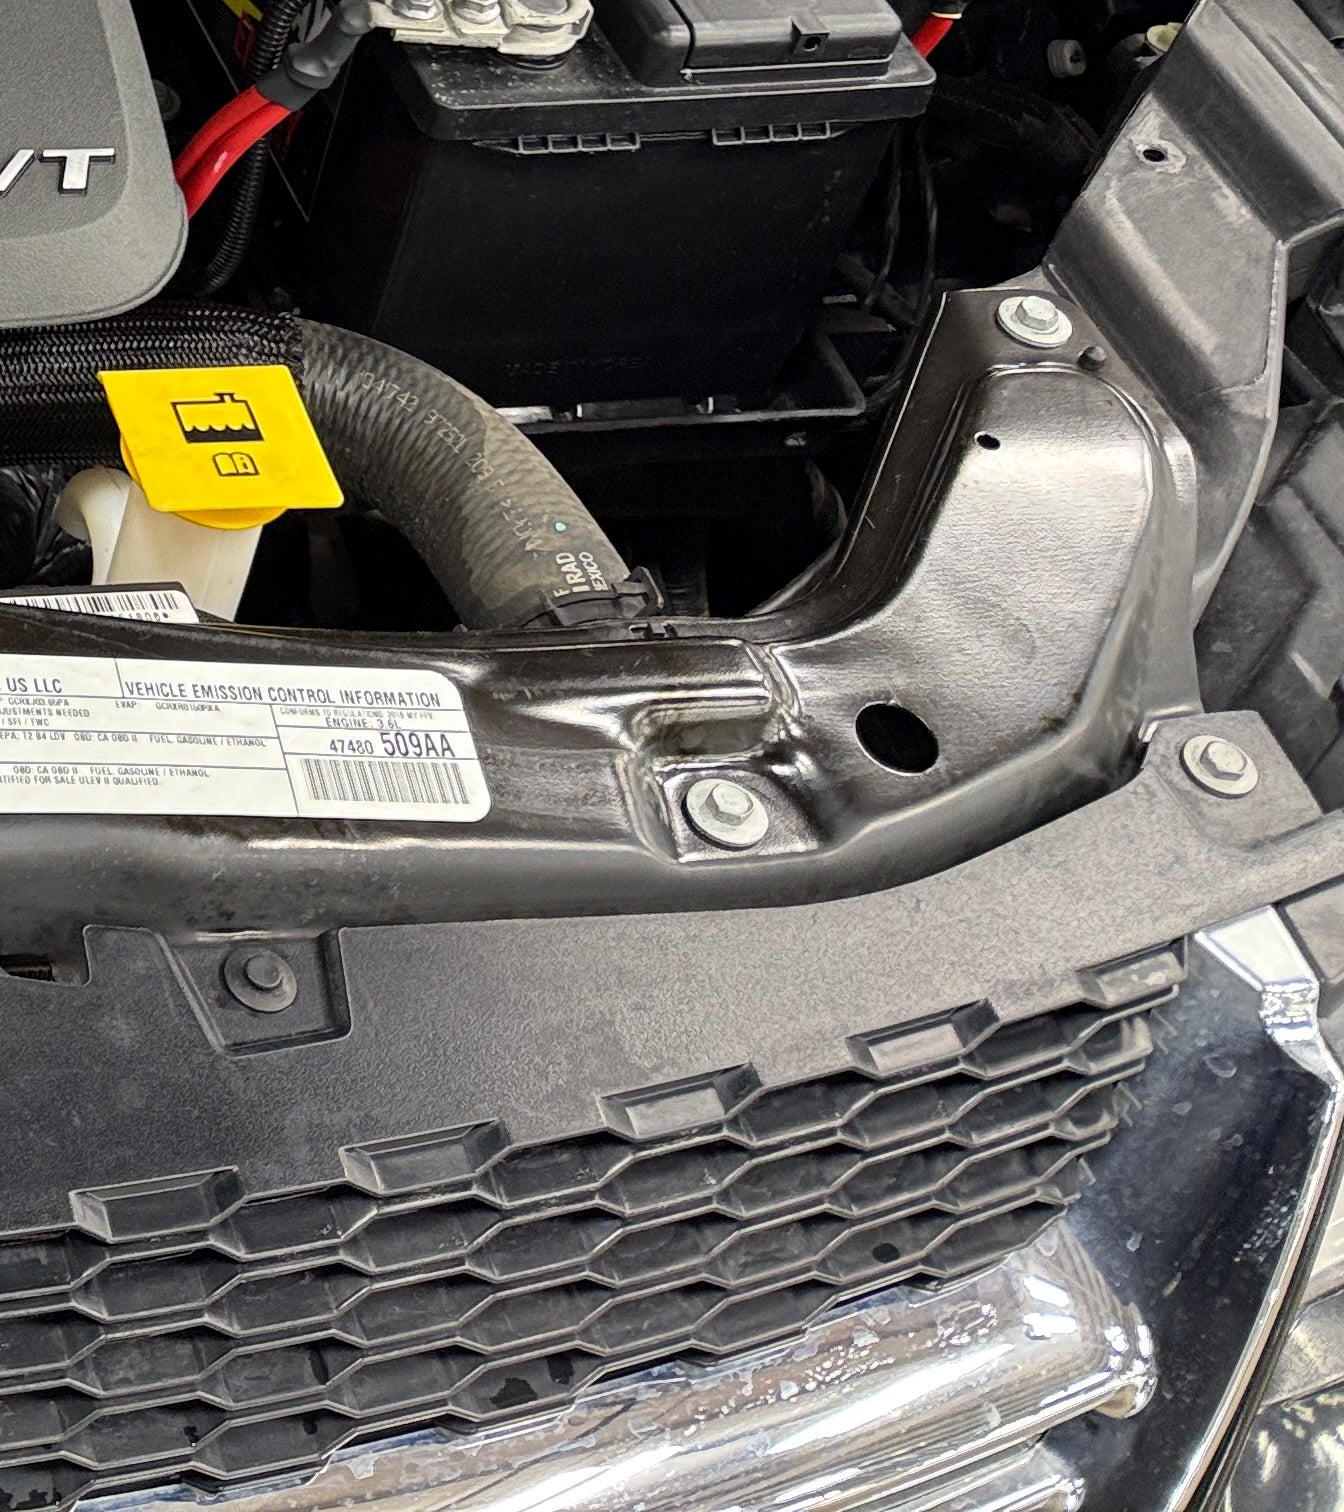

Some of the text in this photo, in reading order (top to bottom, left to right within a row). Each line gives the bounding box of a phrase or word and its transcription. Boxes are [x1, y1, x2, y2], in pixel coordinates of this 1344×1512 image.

[555, 551, 587, 586] RAD
[578, 550, 609, 592] EXICO
[5, 676, 29, 693] US
[33, 677, 63, 694] LLC
[124, 680, 442, 708] VEHICLE EMISSION CONTROL INFORMATION
[55, 707, 91, 718] NEEDED
[30, 718, 50, 727] TWC
[176, 735, 219, 746] GASOLINE
[226, 737, 267, 748] ETHANOL
[329, 731, 457, 759] 47480 509AA
[117, 766, 161, 777] GASOLINE
[168, 768, 211, 778] ETHANOL
[33, 775, 52, 785] FOR
[53, 775, 77, 786] SALE
